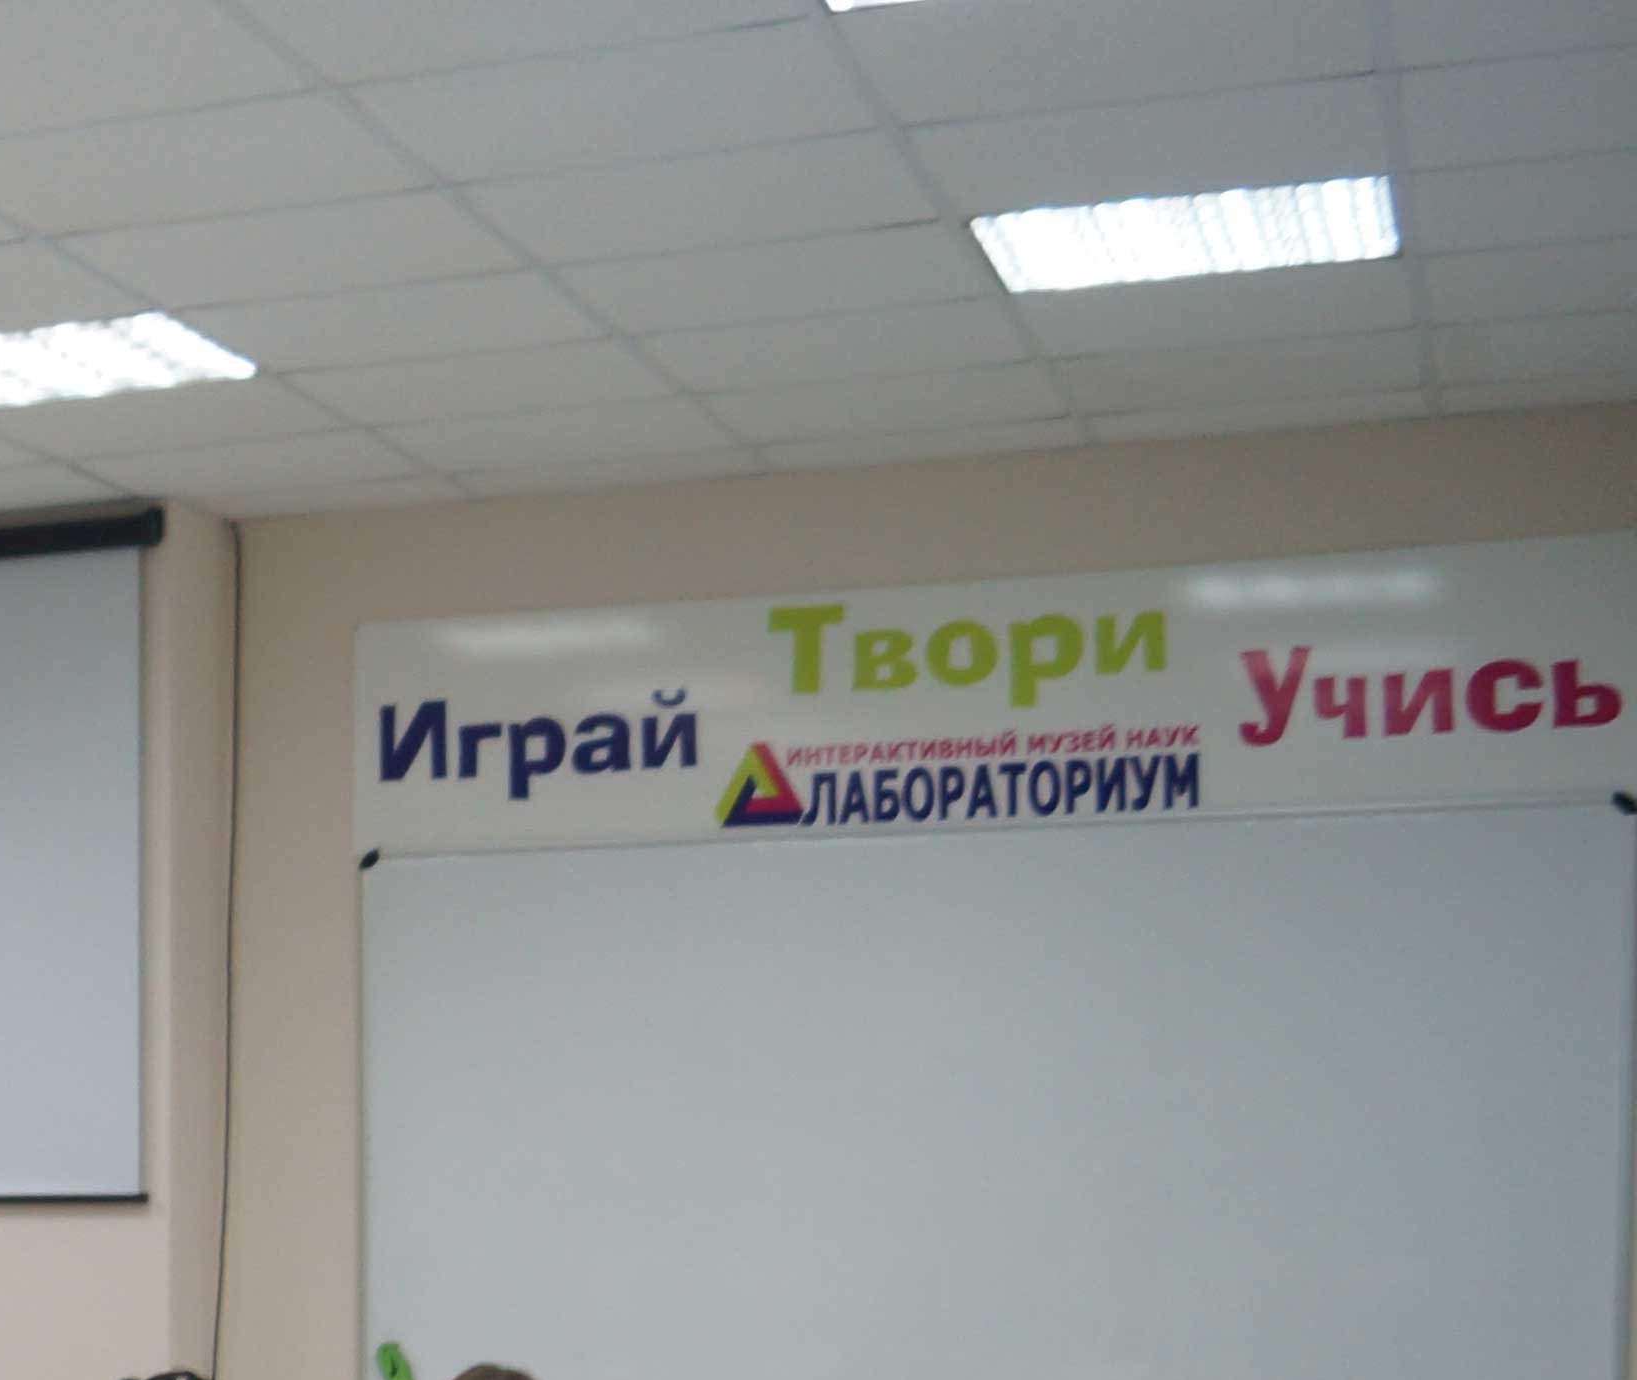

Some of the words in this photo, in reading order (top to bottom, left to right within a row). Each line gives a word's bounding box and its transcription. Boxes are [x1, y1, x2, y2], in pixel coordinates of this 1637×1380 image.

[766, 603, 1169, 707] Твори
[1238, 644, 1624, 748] Учись
[378, 687, 700, 800] Играй
[786, 728, 1017, 767] ИНТЕРАКТИВНЫЙ
[1028, 724, 1117, 754] МУЗЕЙ
[1126, 724, 1201, 749] НАУК
[800, 752, 1201, 826] ЛАБОРАТОРИУМ
